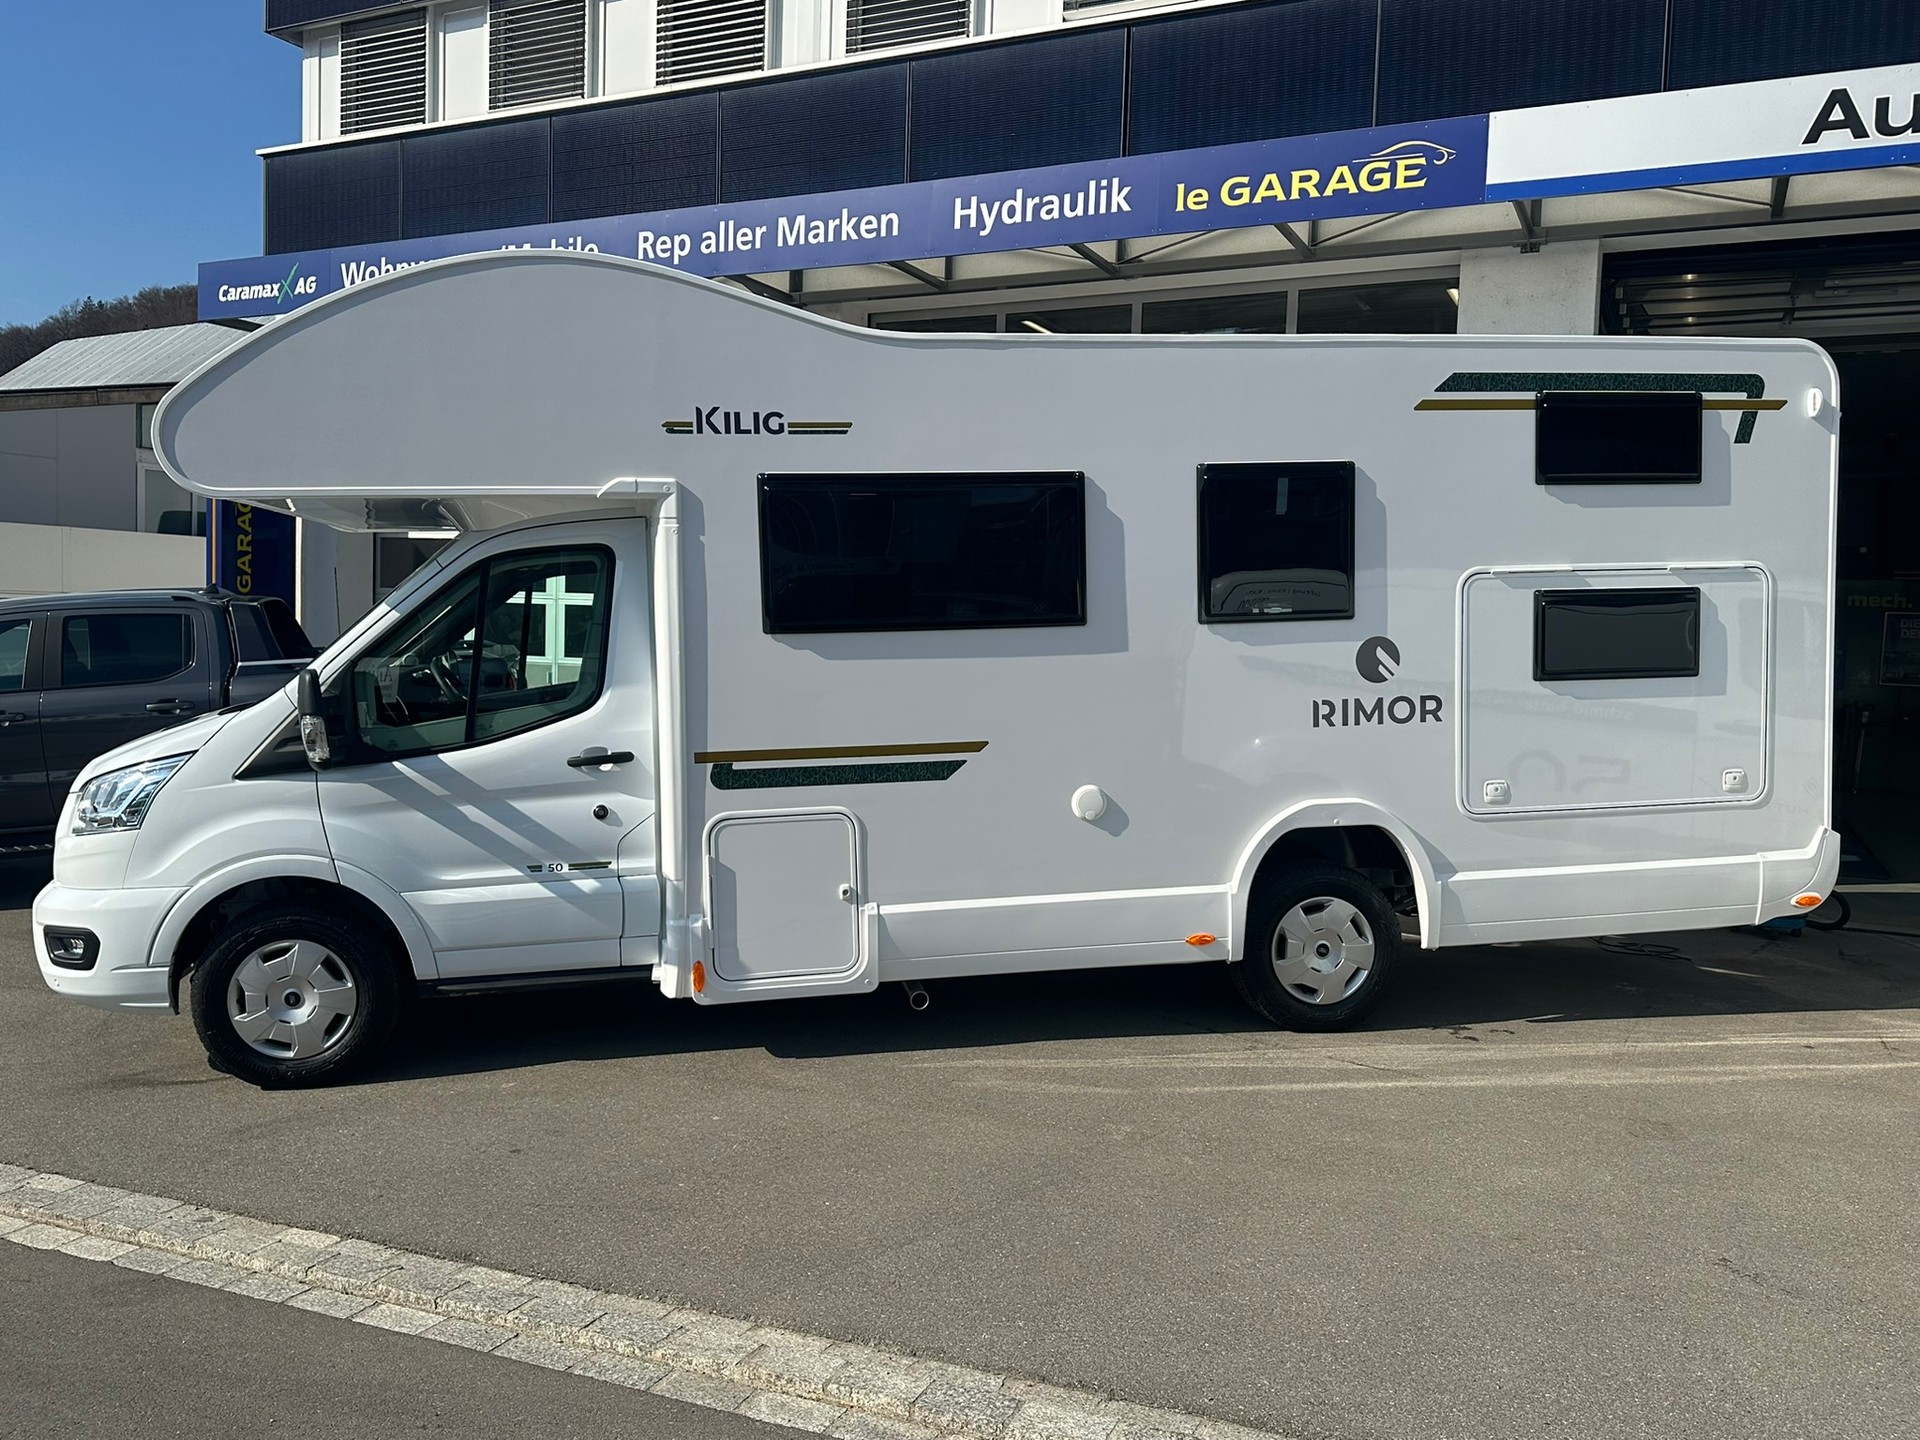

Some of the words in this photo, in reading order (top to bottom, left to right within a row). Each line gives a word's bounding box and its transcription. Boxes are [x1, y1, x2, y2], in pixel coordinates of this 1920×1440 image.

[1175, 183, 1208, 212] le
[1220, 157, 1427, 206] GARAGE
[953, 177, 1132, 236] Hydraulik
[637, 231, 691, 264] Rep
[701, 220, 767, 254] aller
[777, 208, 899, 247] Marken
[294, 276, 317, 295] AG
[695, 406, 785, 435] KILIG
[1847, 593, 1913, 609] mech.
[1312, 694, 1443, 728] RIMOR
[547, 863, 564, 873] 50
